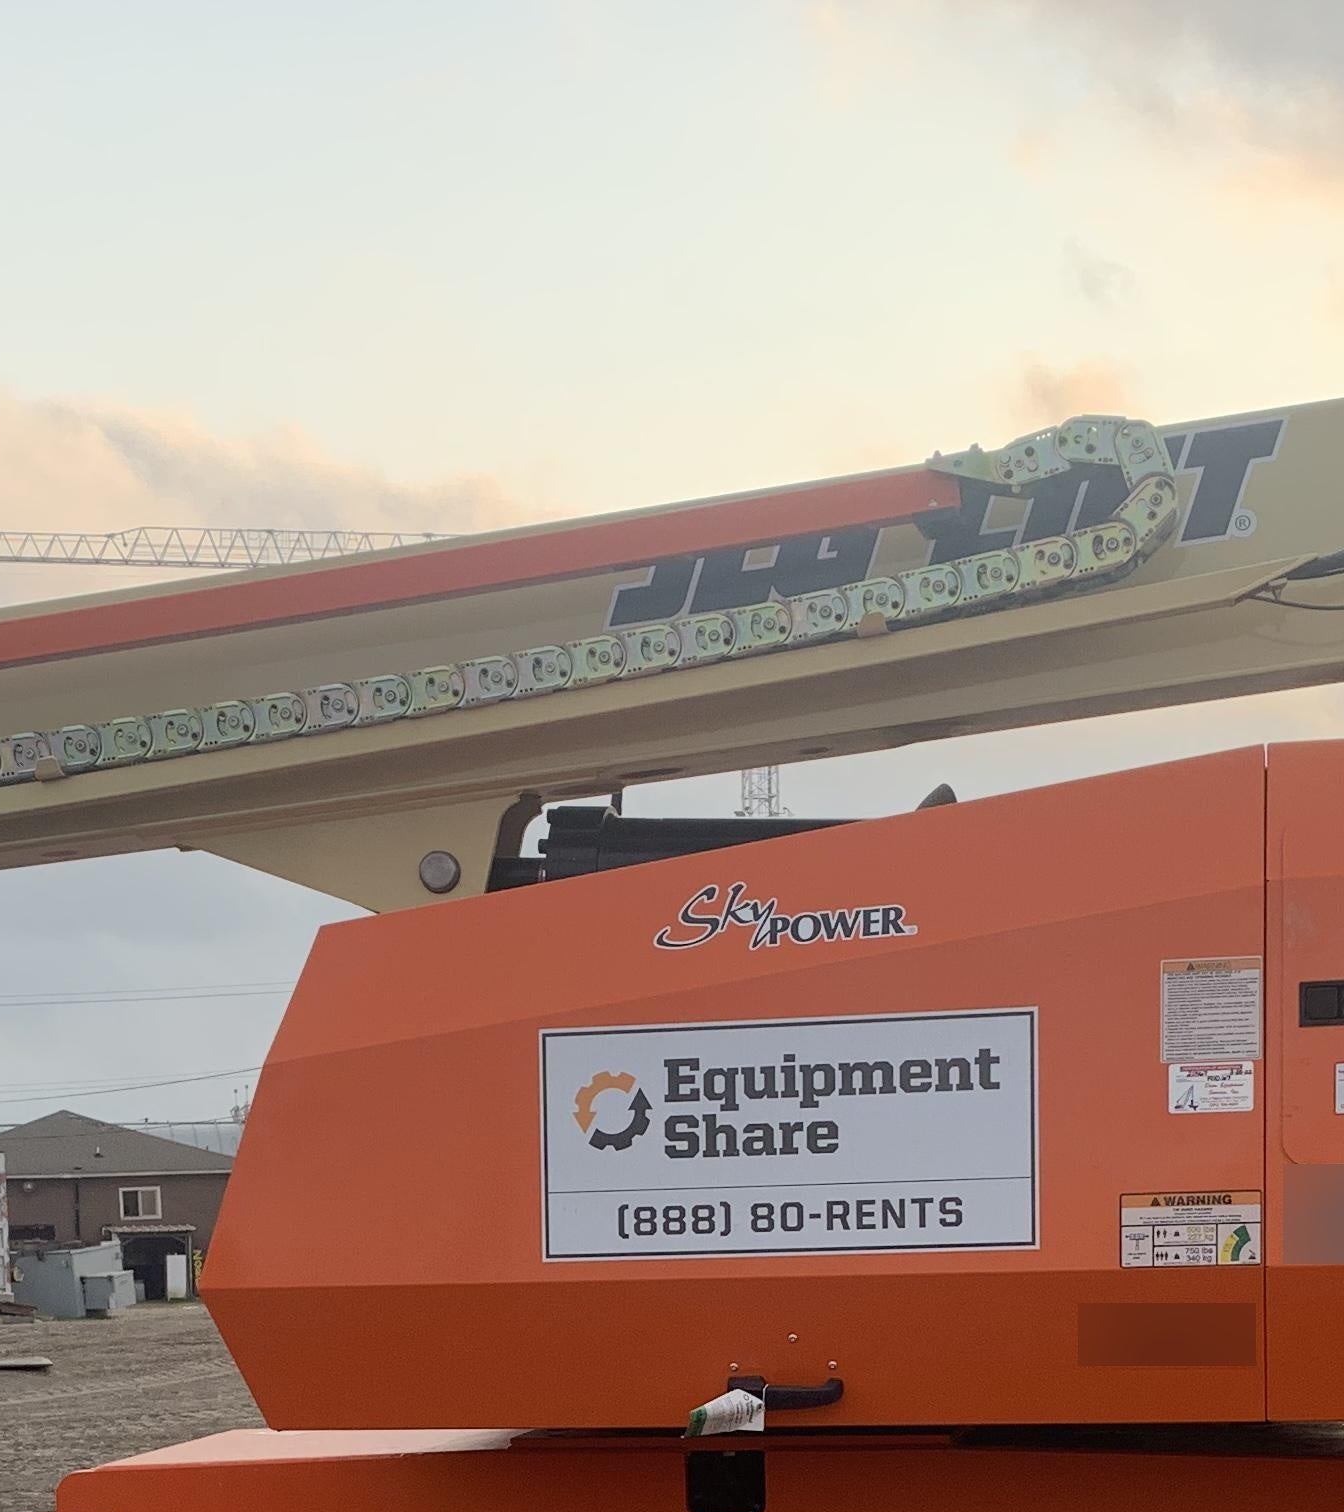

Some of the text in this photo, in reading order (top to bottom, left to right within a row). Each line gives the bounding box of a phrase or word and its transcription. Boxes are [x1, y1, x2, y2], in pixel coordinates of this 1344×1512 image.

[663, 1048, 1001, 1112] Equipment
[663, 1113, 840, 1160] Share
[618, 1196, 964, 1239] (888) 80-RENTS
[1164, 1194, 1232, 1206] WARNING
